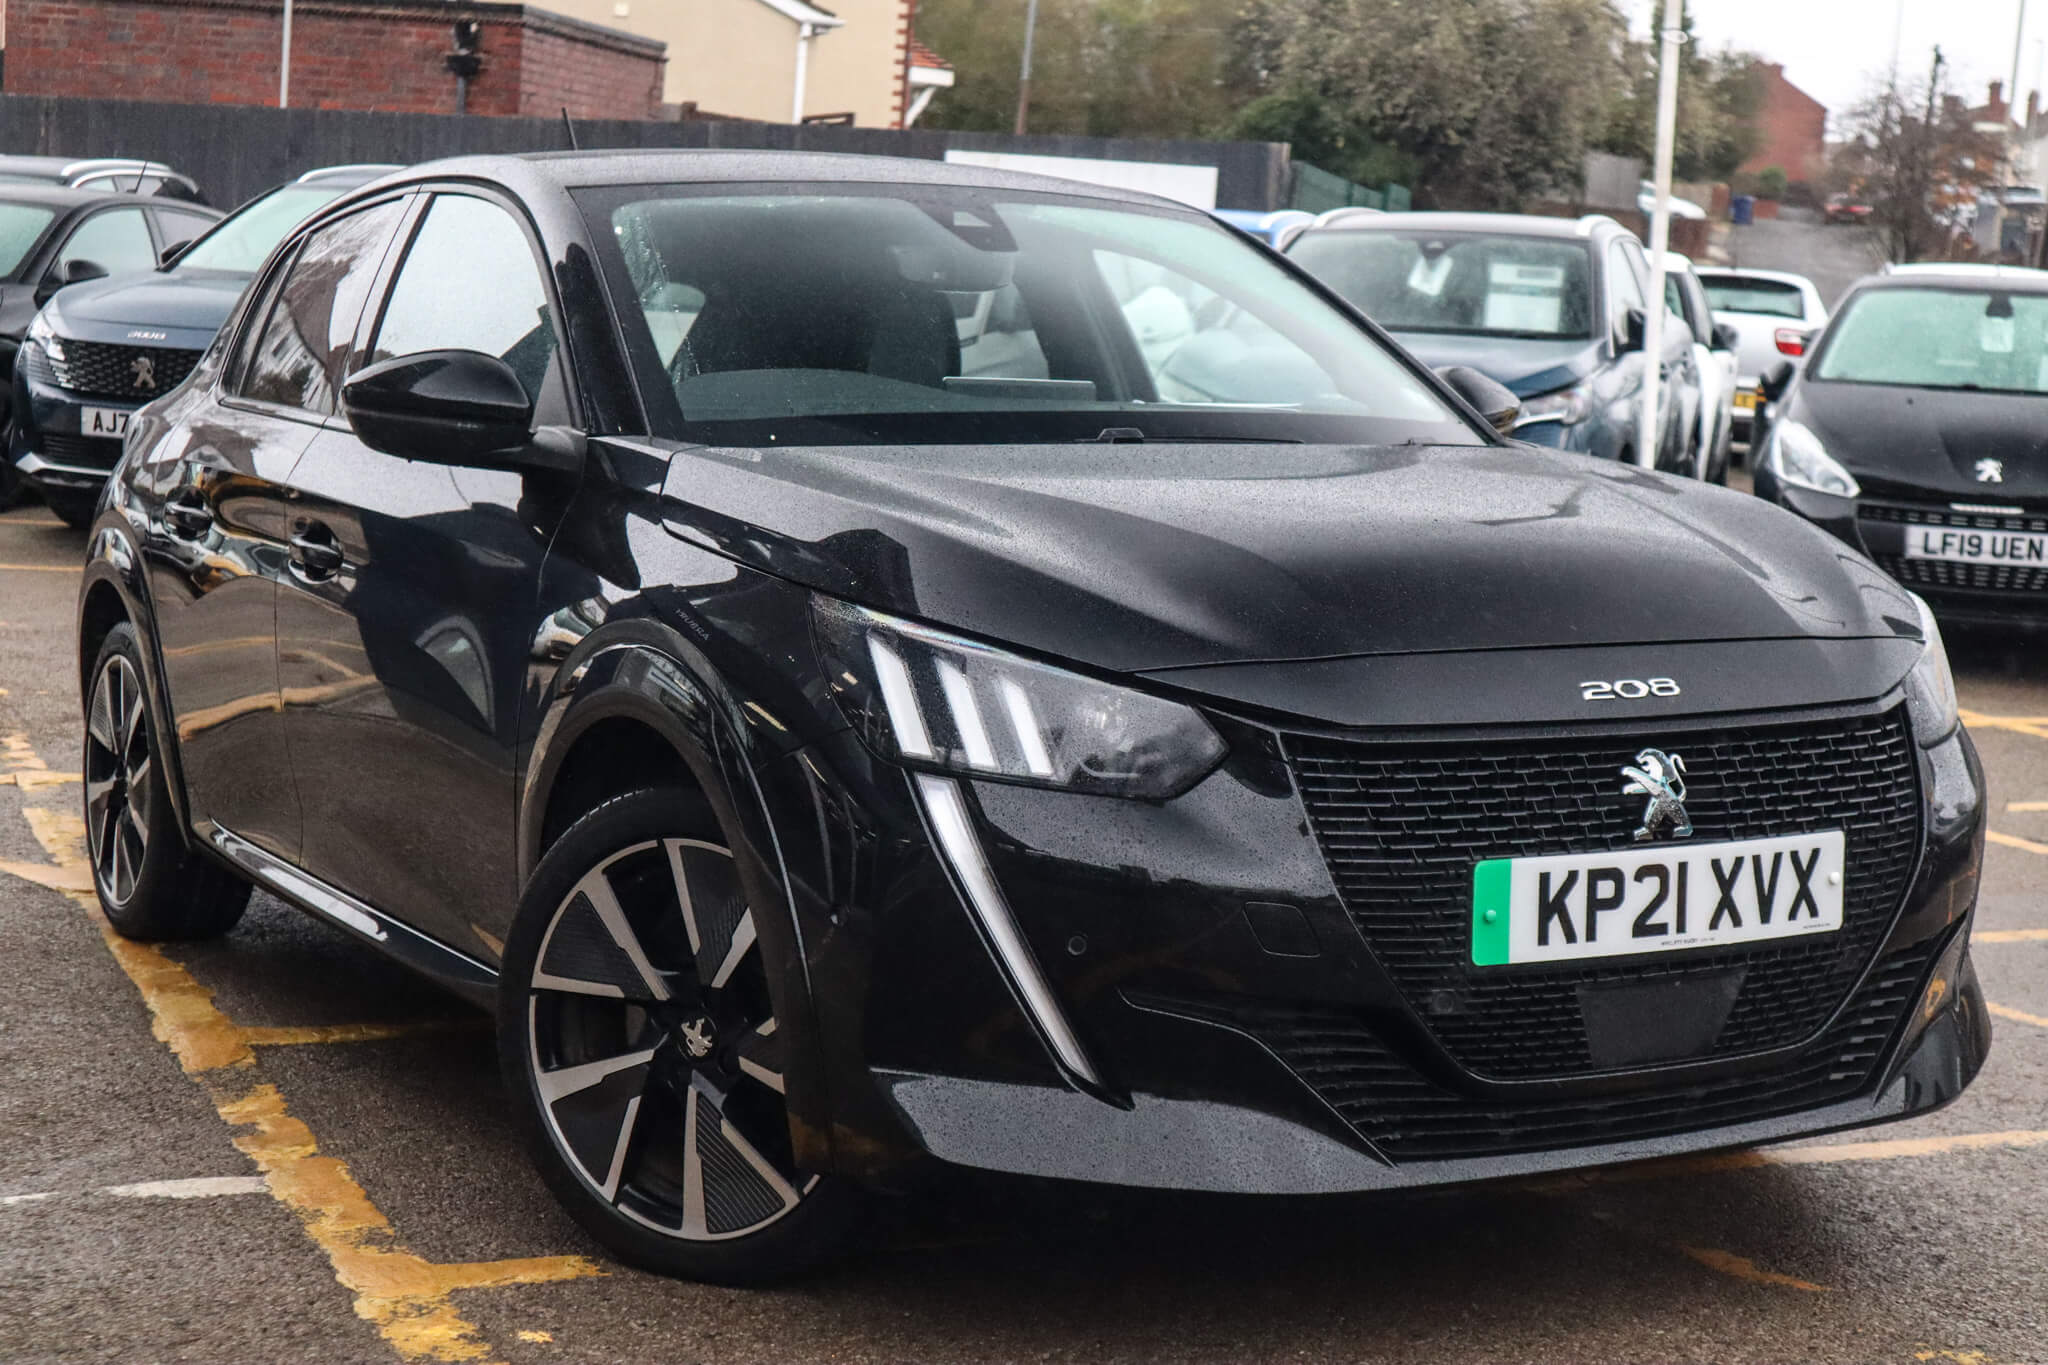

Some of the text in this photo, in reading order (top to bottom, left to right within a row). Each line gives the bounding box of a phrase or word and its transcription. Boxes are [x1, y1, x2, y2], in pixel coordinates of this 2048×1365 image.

[1923, 532, 2044, 562] LF19 UEN
[1579, 678, 1681, 700] 208
[1537, 847, 1821, 947] KP21 XVX
